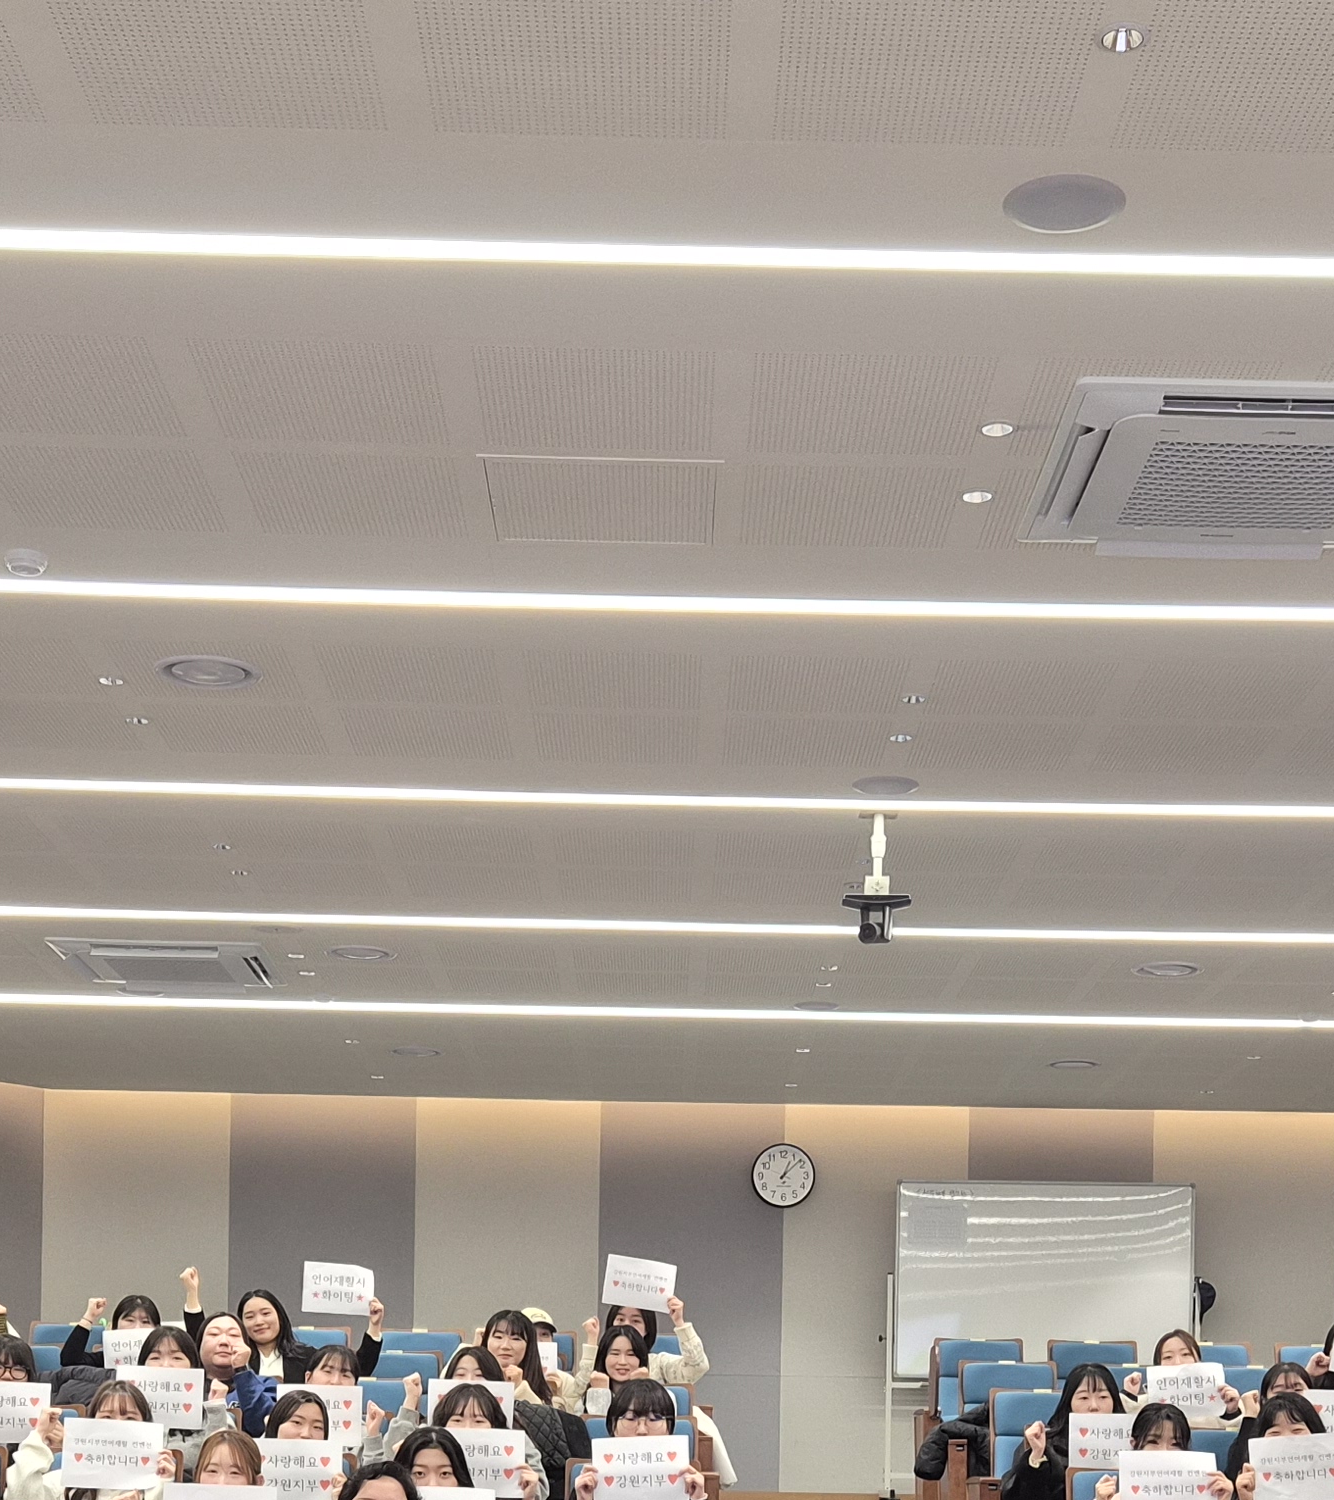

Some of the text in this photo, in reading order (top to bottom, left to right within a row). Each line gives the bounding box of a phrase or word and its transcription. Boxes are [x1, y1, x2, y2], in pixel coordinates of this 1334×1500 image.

[311, 1273, 366, 1288] 언어재활사
[620, 1281, 659, 1295] 축하합니다
[321, 1289, 354, 1304] 화이팅
[111, 1339, 143, 1352] 언어재
[1155, 1375, 1216, 1391] 언어재활사
[1169, 1392, 1205, 1406] 화이팅
[149, 1402, 182, 1413] 원지부
[464, 1444, 502, 1457] 랑해요
[616, 1451, 665, 1464] 사랑해요
[84, 1453, 140, 1467] 축하합니다
[267, 1455, 319, 1468] 사랑해요
[1273, 1466, 1327, 1481] 축하합니다
[616, 1474, 666, 1488] 강원지부
[1141, 1483, 1195, 1496] 축하합니다
